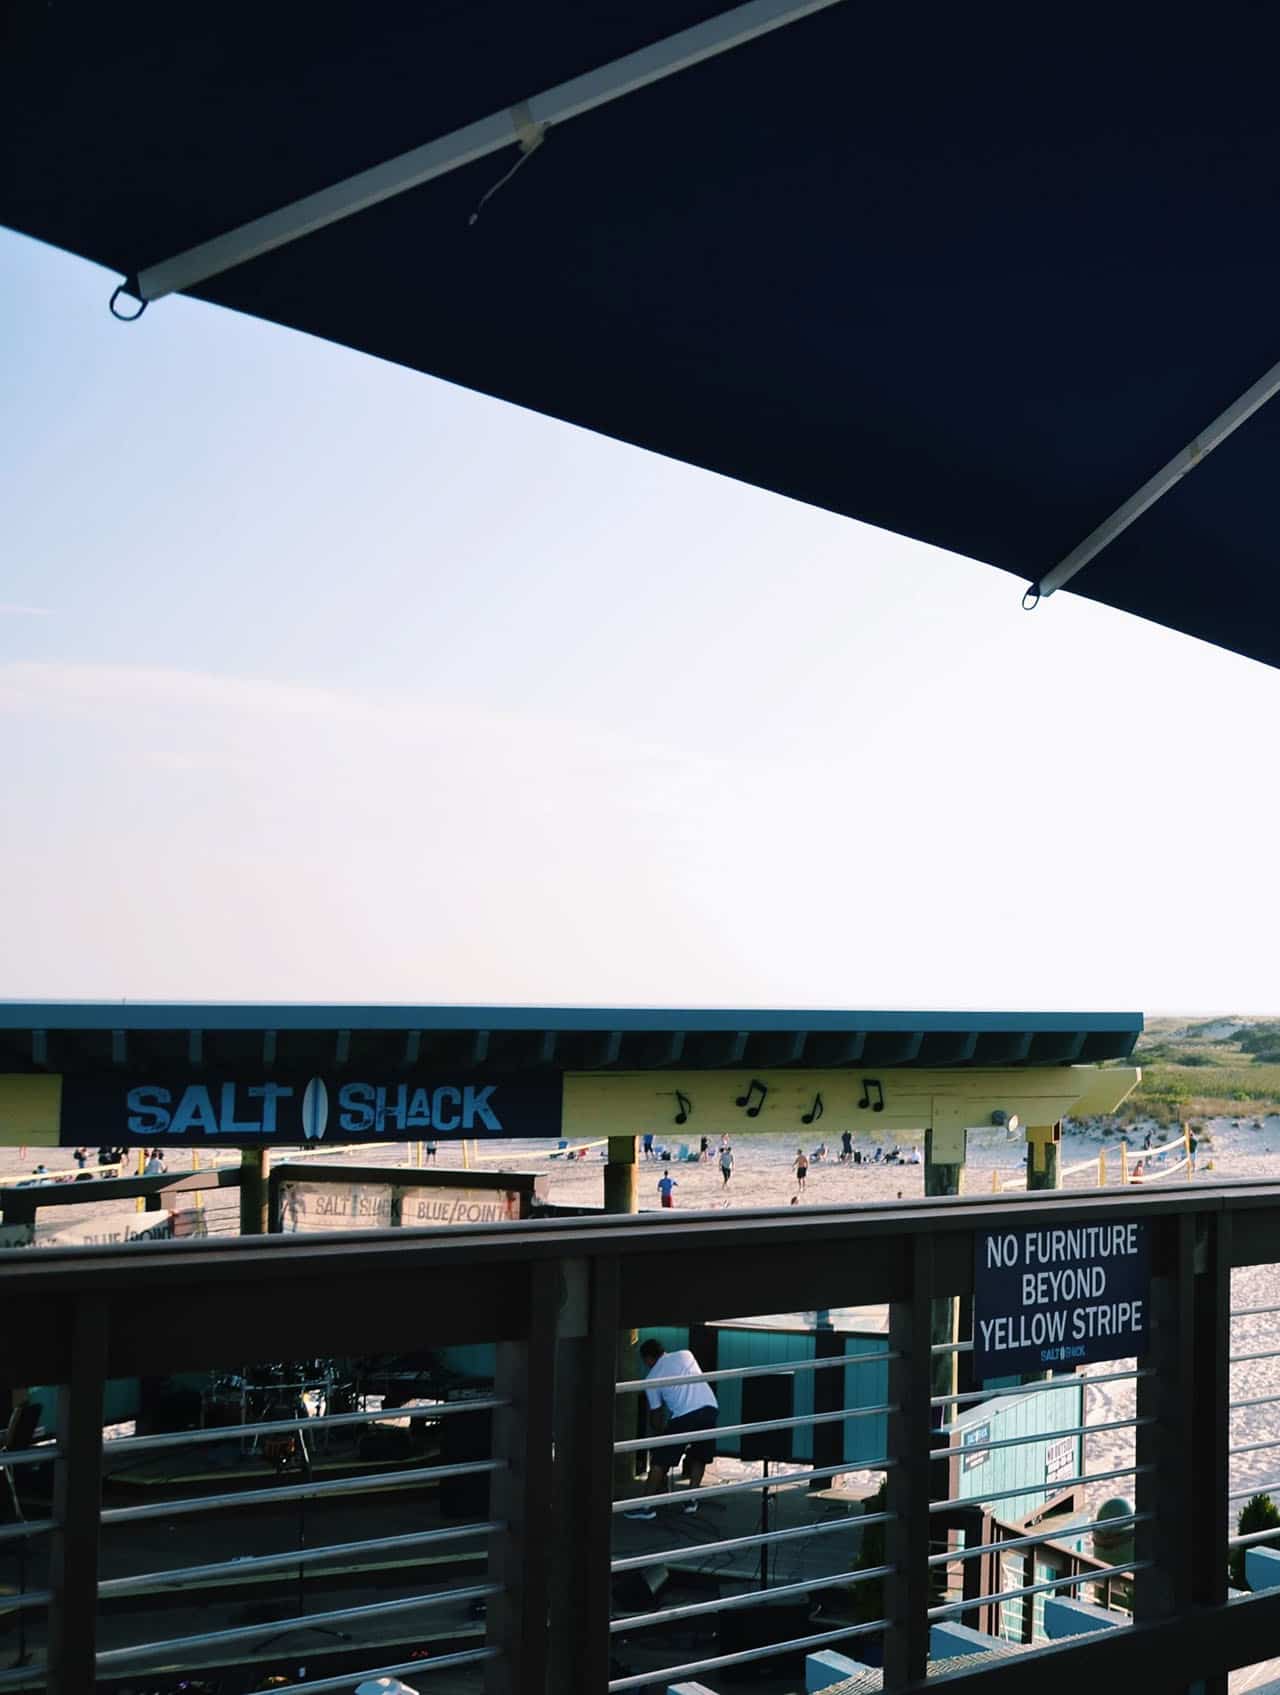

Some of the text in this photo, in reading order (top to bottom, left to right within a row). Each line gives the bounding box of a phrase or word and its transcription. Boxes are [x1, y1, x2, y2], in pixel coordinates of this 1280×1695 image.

[127, 1082, 503, 1134] SALT SHACK
[986, 1224, 1138, 1268] NO FURNITURE
[1022, 1266, 1106, 1306] BEYOND
[980, 1301, 1143, 1352] YELLOW STRIPE
